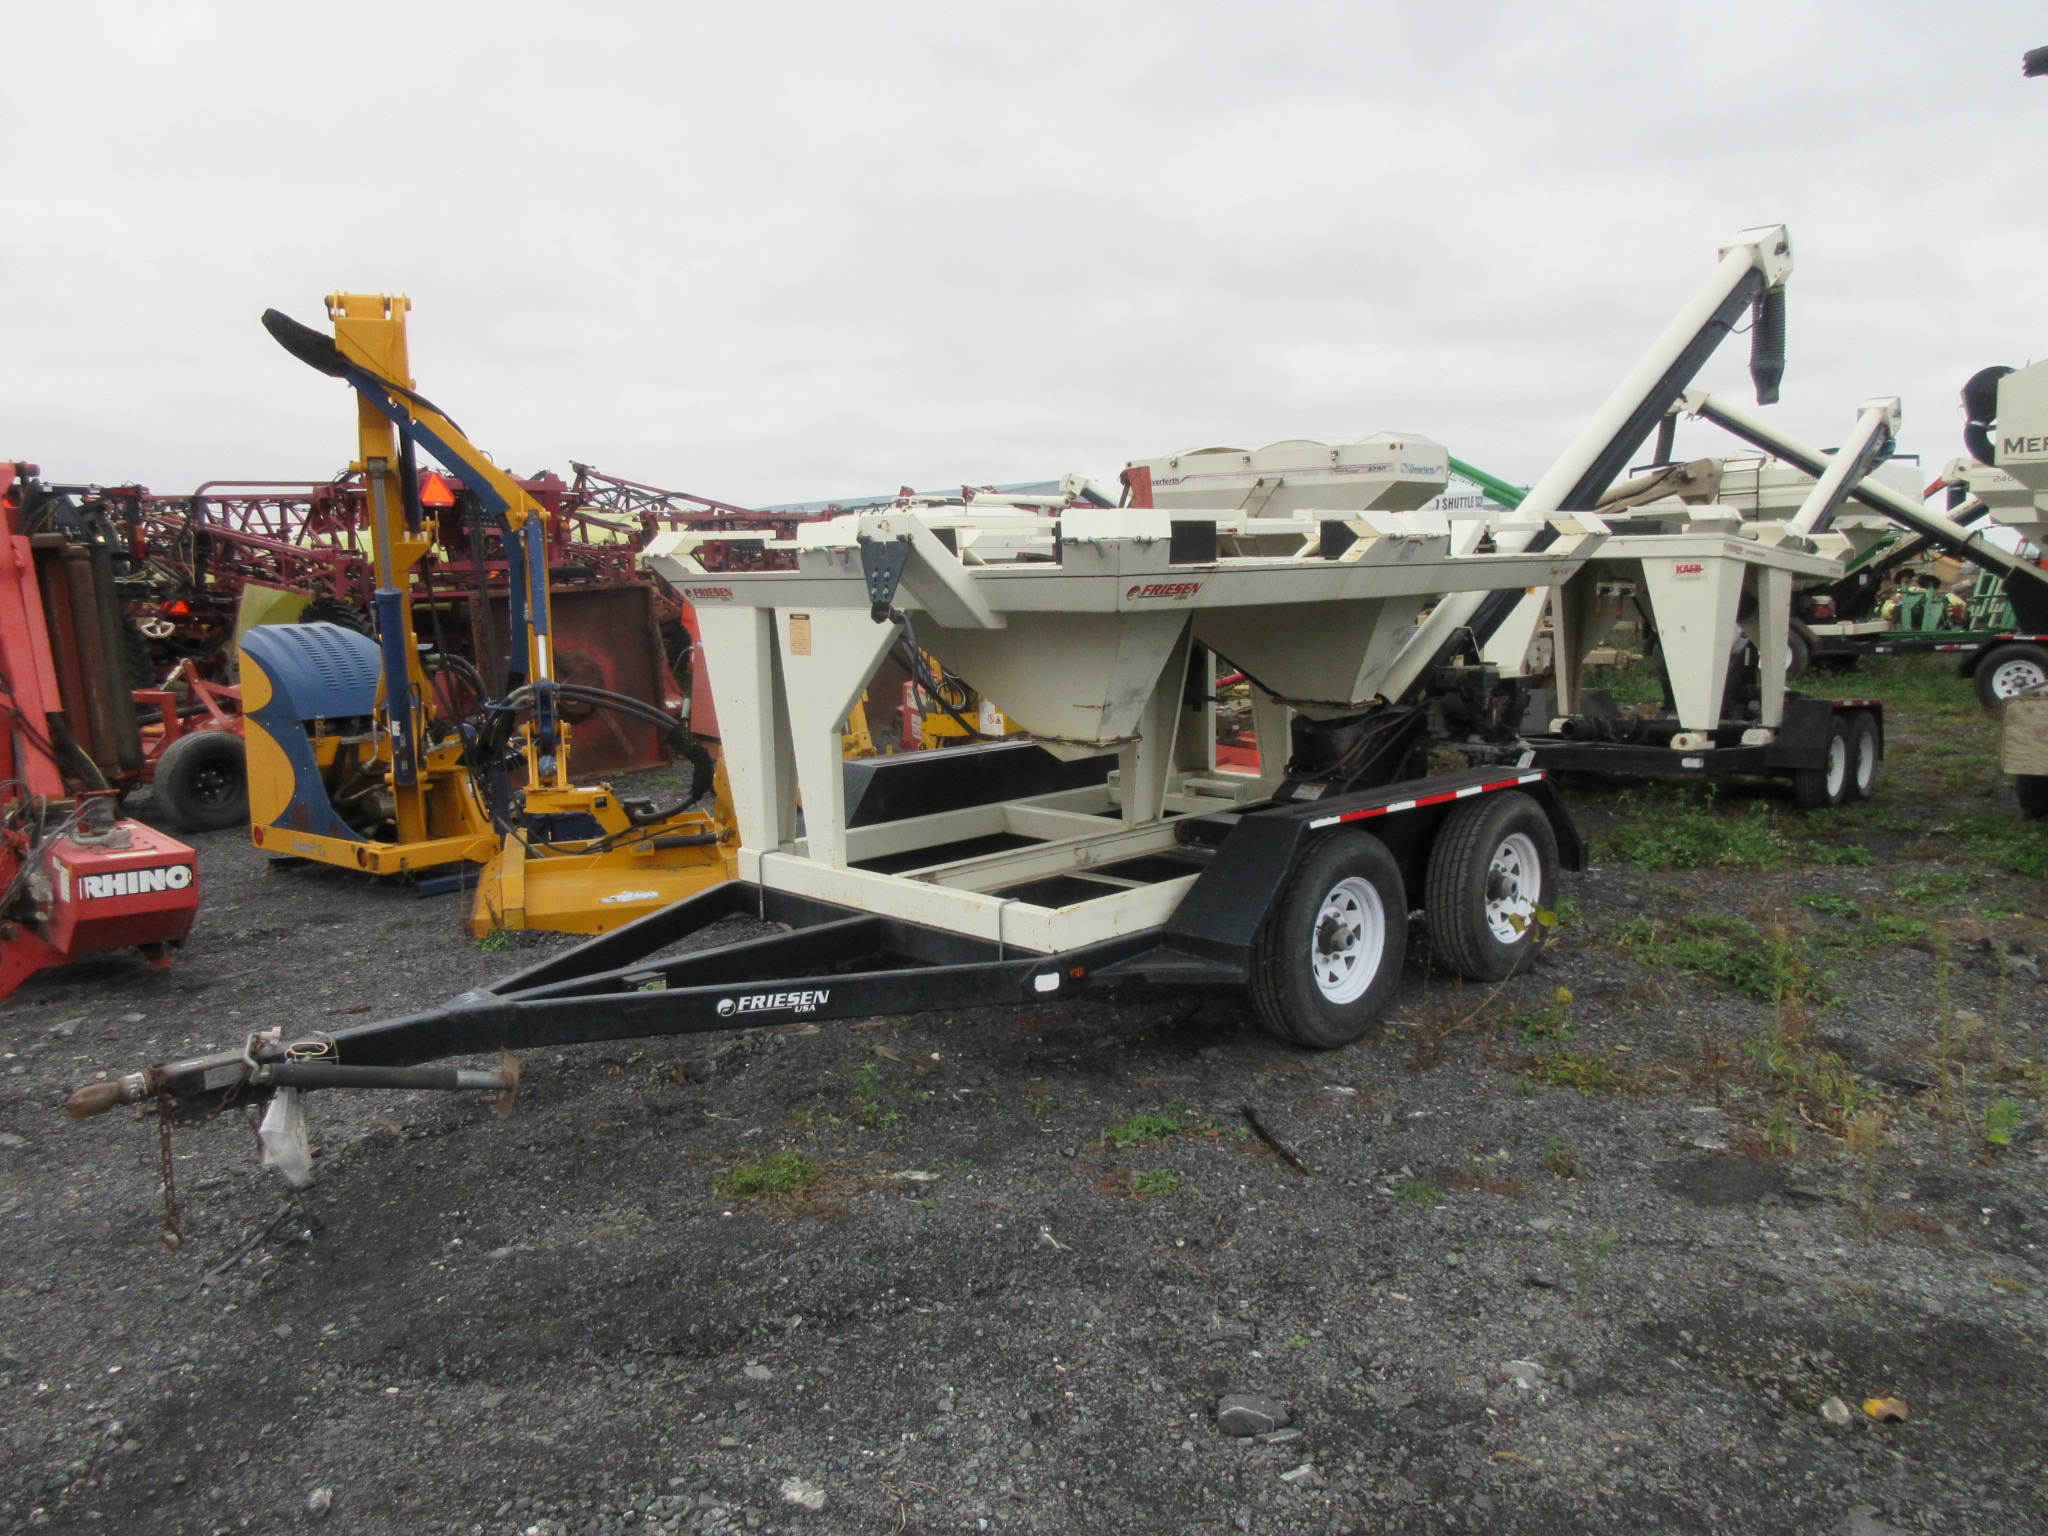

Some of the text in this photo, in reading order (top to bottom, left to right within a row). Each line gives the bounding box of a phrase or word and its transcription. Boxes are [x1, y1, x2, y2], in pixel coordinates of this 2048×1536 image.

[1442, 496, 1474, 510] SHUTTLE
[693, 587, 734, 597] FRIESEN
[1140, 582, 1203, 596] FRIESEN
[79, 865, 192, 900] RHINO
[738, 990, 830, 1011] FRIESEN
[795, 1004, 816, 1013] USA
